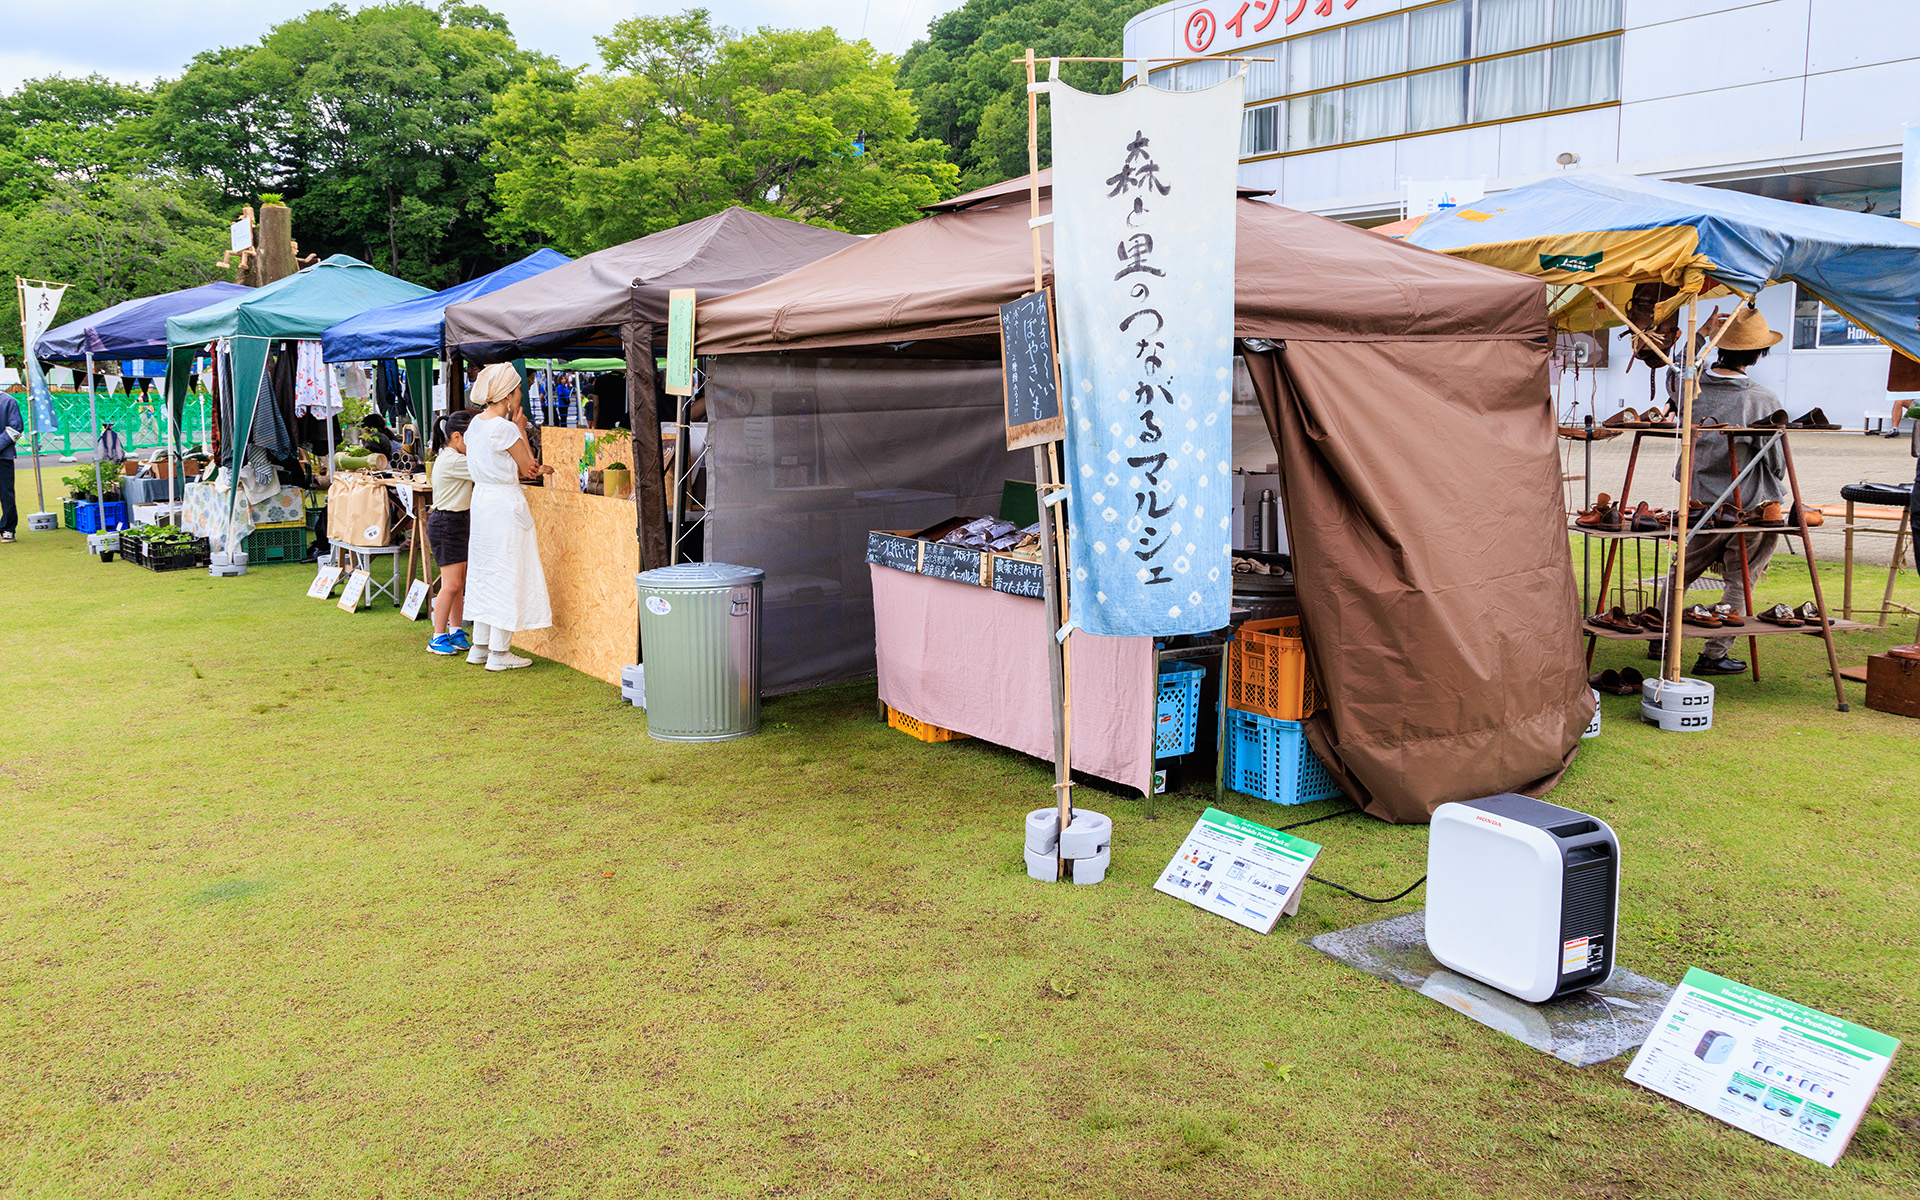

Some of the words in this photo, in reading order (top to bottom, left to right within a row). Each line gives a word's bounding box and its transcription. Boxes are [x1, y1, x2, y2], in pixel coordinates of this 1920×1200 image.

[1224, 0, 1357, 38] インフォ
[1021, 301, 1043, 421] つぼやきいも
[1106, 130, 1177, 585] 森と里のつながるマルシェ
[880, 538, 918, 562] つぼやきいも
[995, 575, 1041, 597] 育てたお米です
[1476, 815, 1502, 827] HONDA
[1721, 988, 1748, 1003] Honda
[1749, 998, 1776, 1012] Power
[1775, 1007, 1794, 1019] Pod
[1803, 1019, 1848, 1039] Prototype
